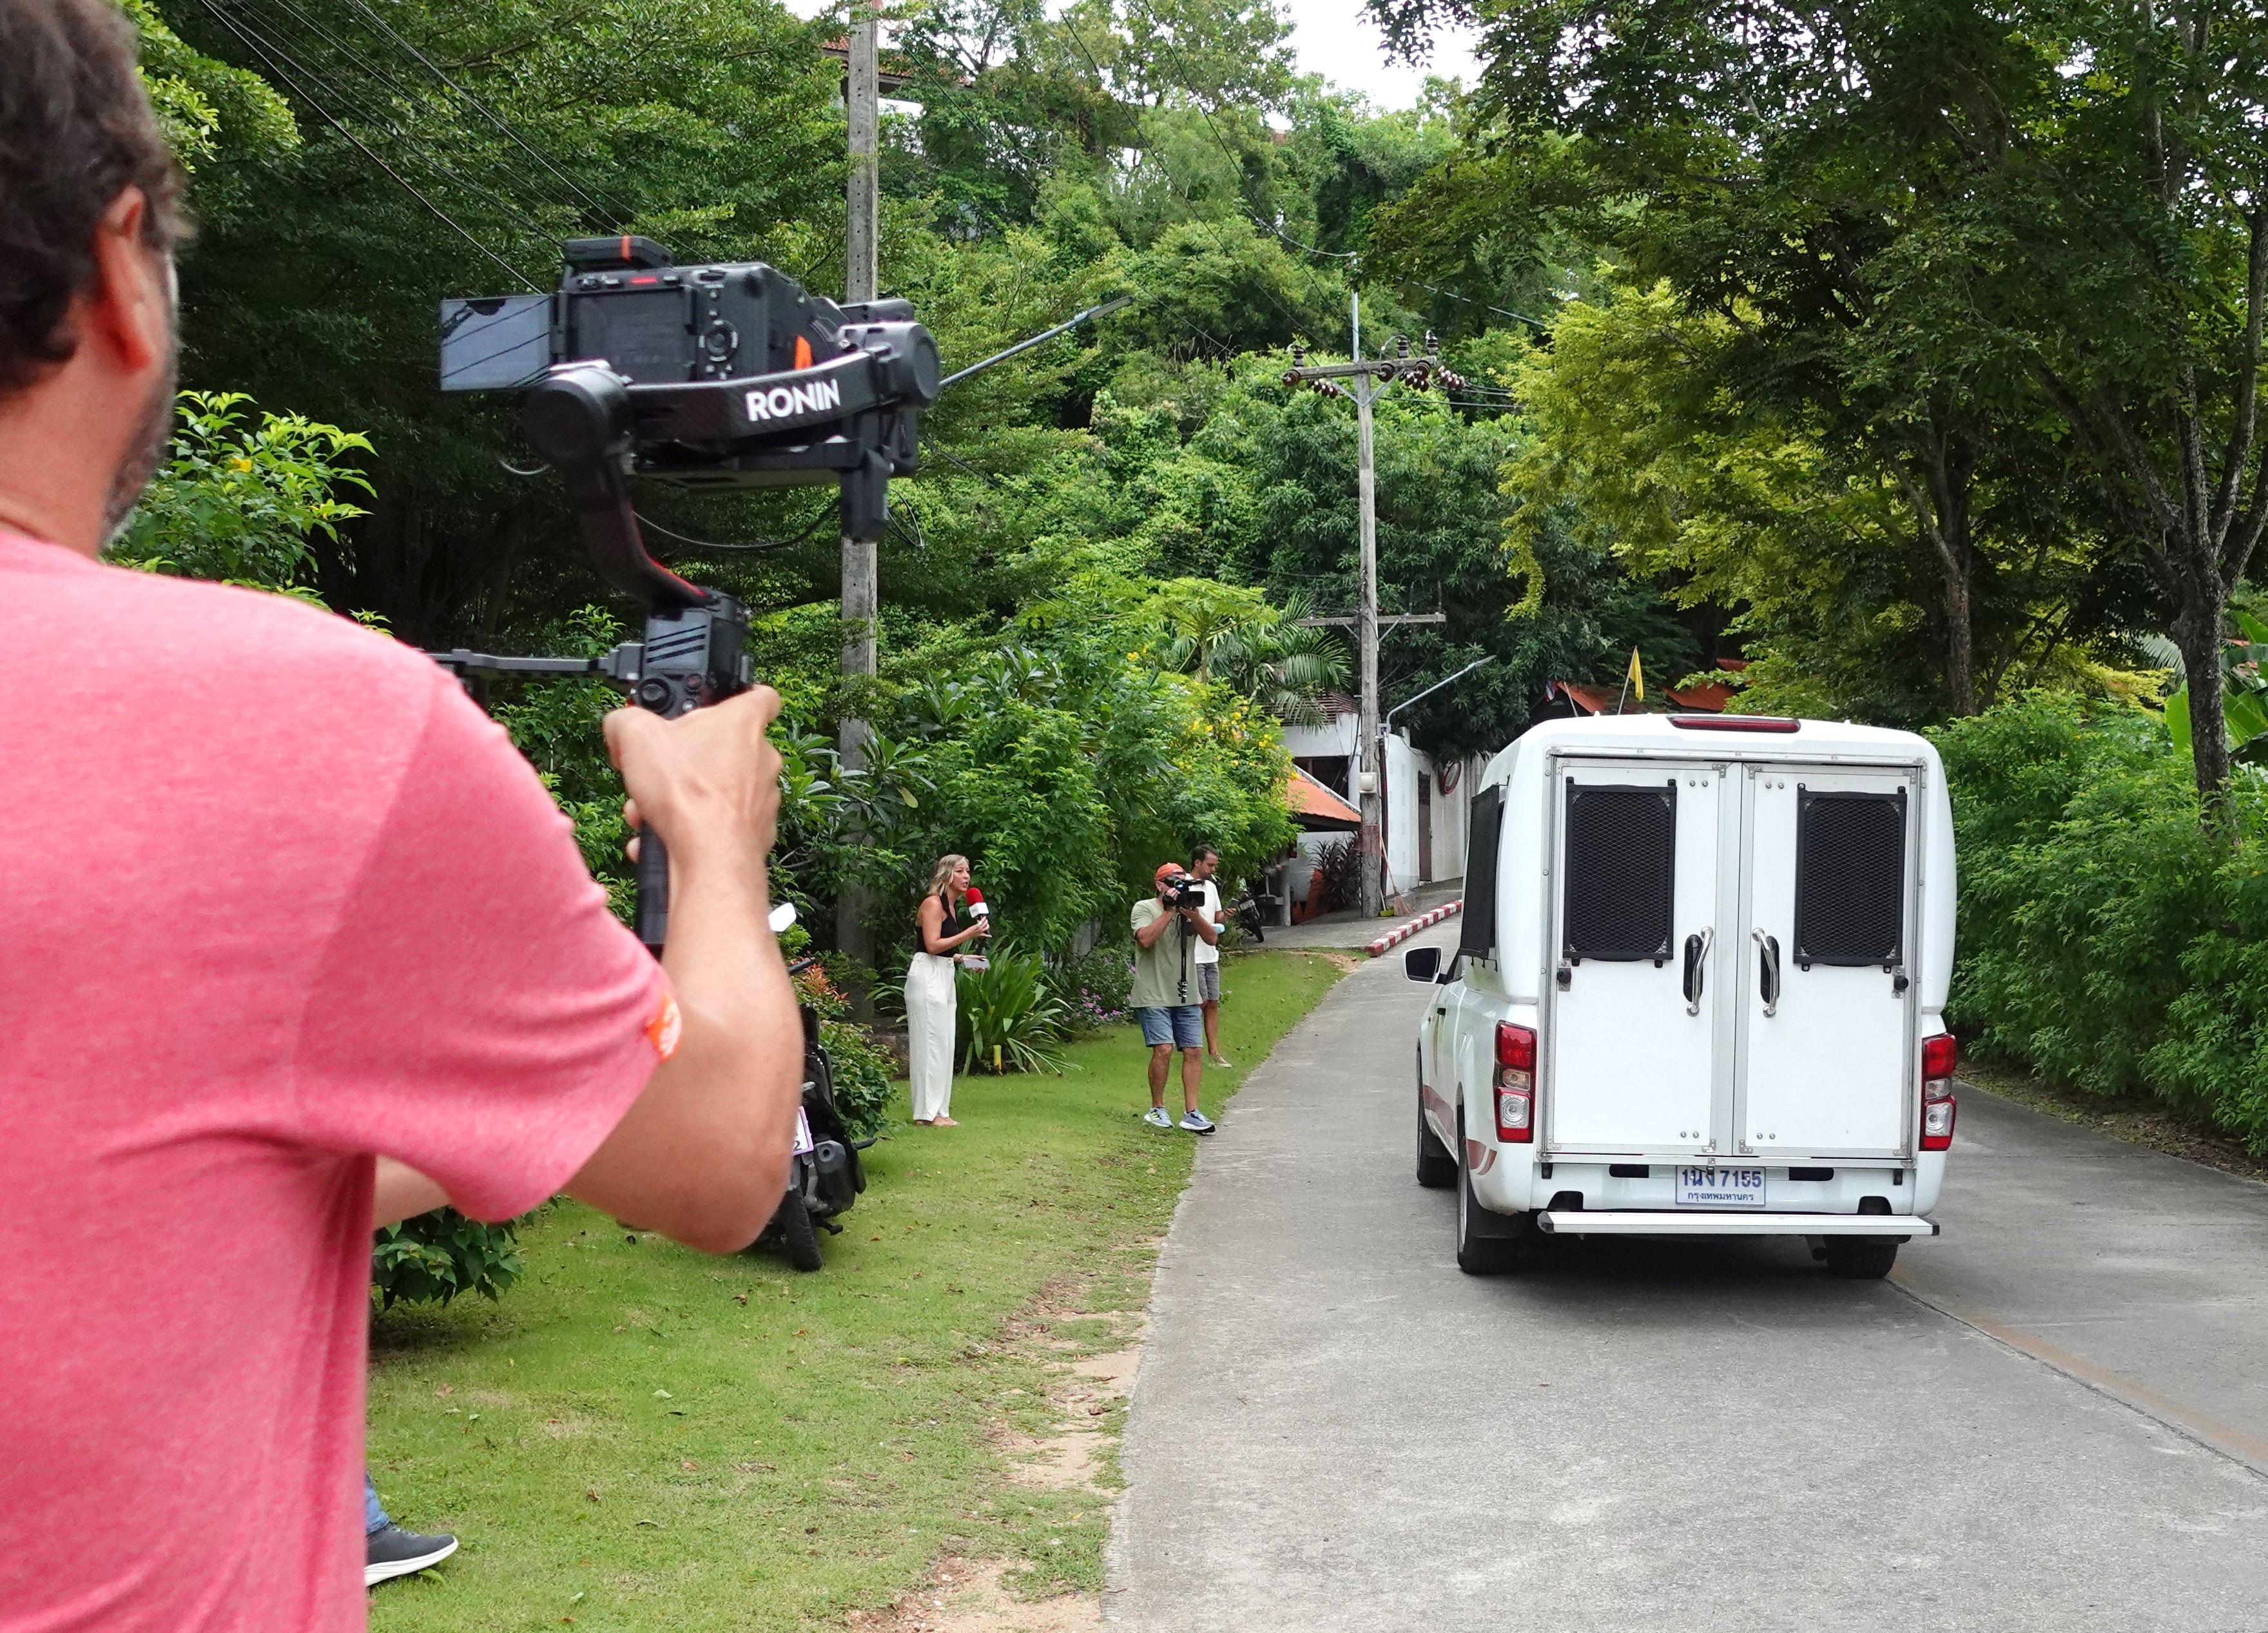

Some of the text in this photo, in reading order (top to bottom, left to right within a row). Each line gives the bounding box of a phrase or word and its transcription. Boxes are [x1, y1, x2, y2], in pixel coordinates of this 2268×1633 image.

[746, 378, 840, 422] RONIN
[1720, 1169, 1761, 1187] 7155
[1687, 1192, 1754, 1201] กรุงเทพมหานคร
